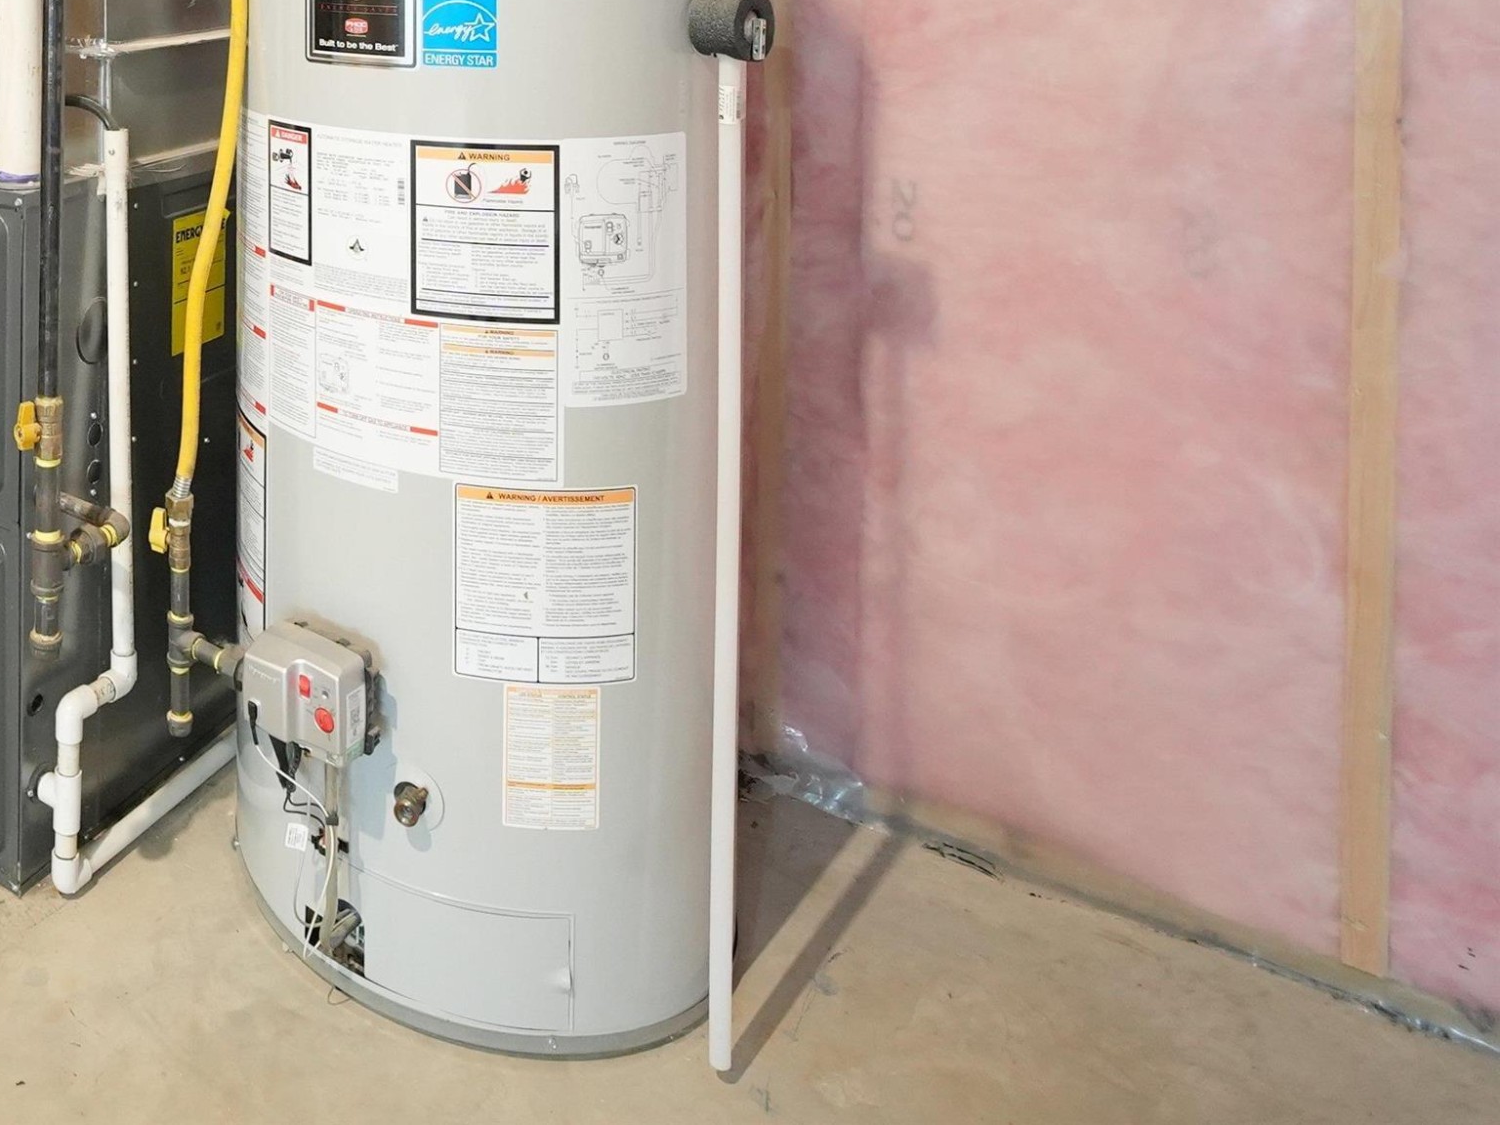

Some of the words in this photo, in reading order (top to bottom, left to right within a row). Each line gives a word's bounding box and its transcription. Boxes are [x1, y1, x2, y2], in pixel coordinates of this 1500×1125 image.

[319, 38, 336, 47] Built
[337, 40, 345, 48] to
[346, 40, 357, 49] be
[359, 41, 373, 50] the
[375, 43, 396, 52] Best
[424, 53, 464, 66] ENERGY
[466, 53, 494, 67] STAR
[468, 153, 511, 161] WARNING
[498, 493, 536, 502] WARNING
[542, 495, 605, 503] AVERTISSEMENT
